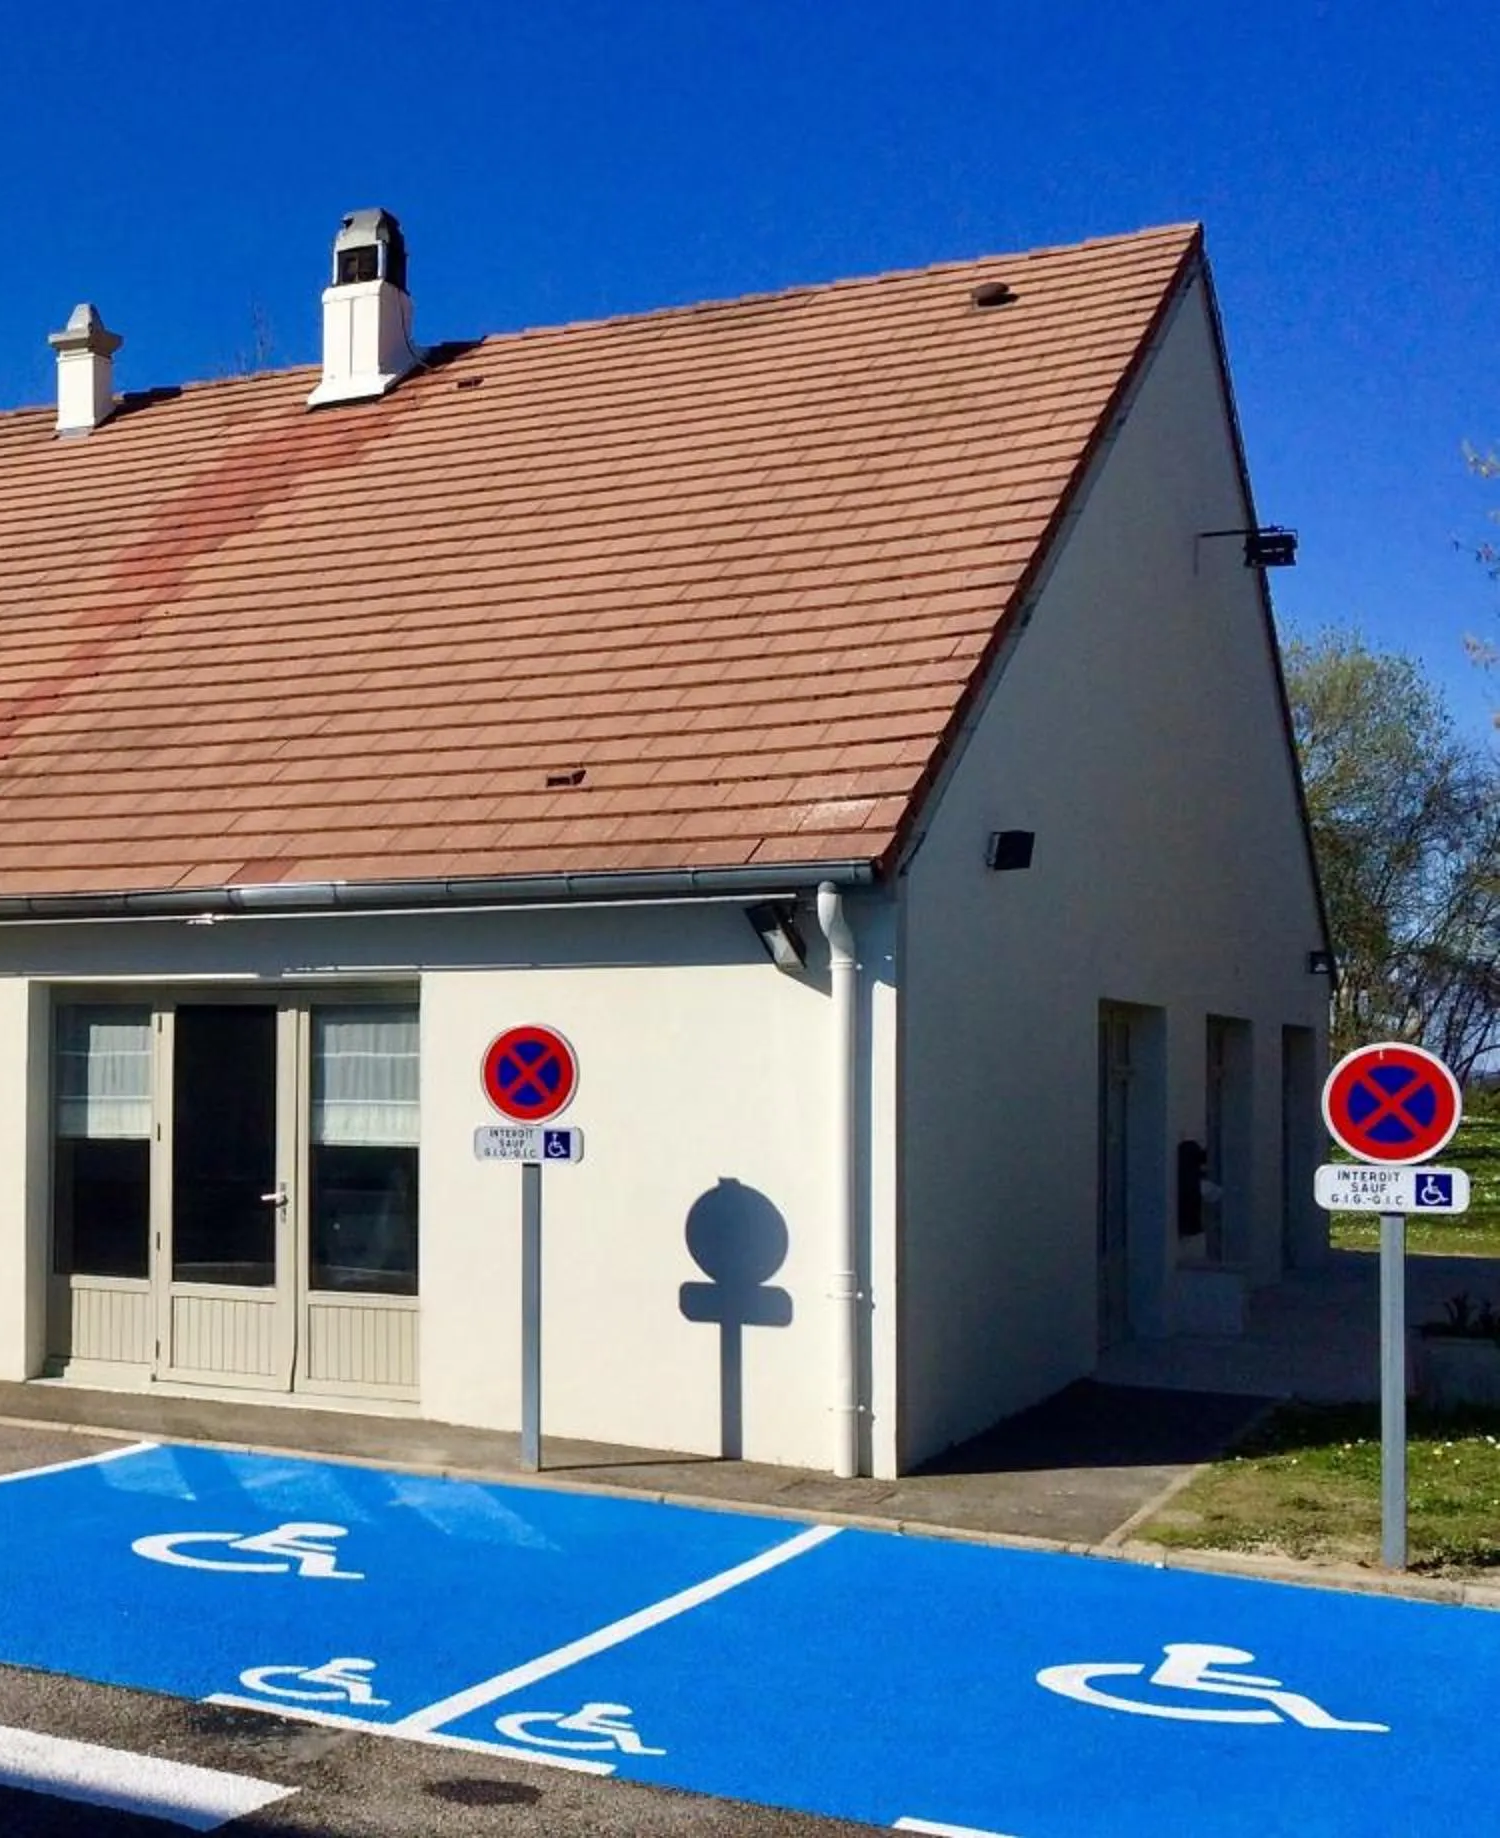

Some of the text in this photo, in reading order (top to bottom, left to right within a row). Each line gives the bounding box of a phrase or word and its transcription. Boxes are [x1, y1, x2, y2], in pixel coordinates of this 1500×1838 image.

[489, 1128, 533, 1139] INTERDIT
[499, 1139, 525, 1148] SAUF
[1337, 1170, 1401, 1182] INTERDIT
[1351, 1182, 1387, 1193] SAUF
